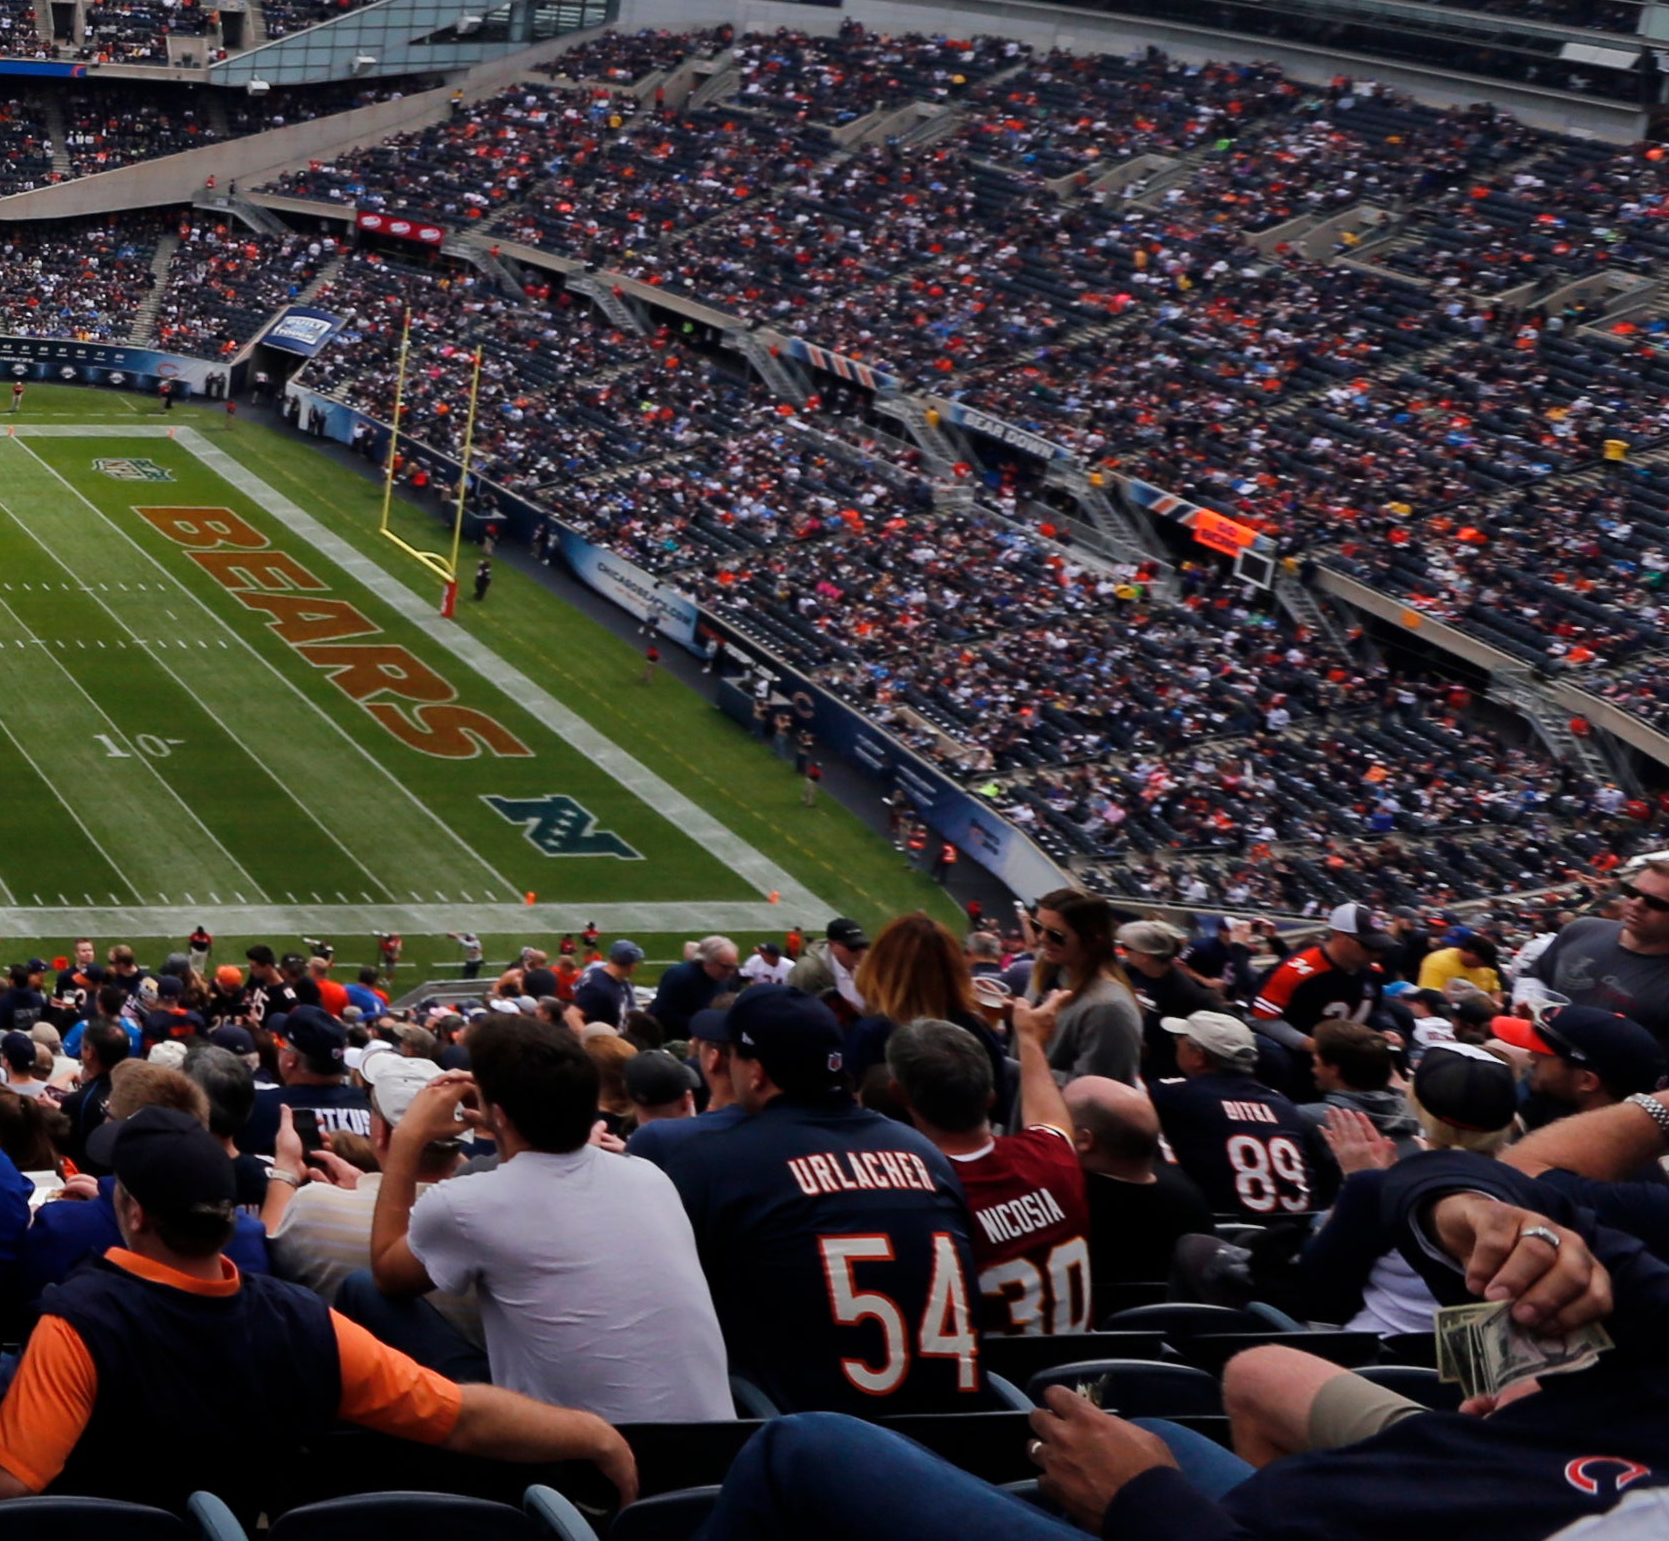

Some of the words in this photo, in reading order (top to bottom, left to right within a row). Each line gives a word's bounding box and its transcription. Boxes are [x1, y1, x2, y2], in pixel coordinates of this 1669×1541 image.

[964, 411, 1004, 439] BEAR
[1004, 430, 1055, 459] DOWN
[130, 506, 537, 759] BEARS
[93, 732, 173, 759] 10
[315, 1107, 371, 1138] TKUS
[1220, 1100, 1279, 1125] DITKA
[787, 1151, 937, 1197] URLACHER
[1226, 1134, 1311, 1213] 89
[975, 1187, 1066, 1245] NICOSIA
[977, 1236, 1092, 1339] 30
[816, 1232, 979, 1397] 54
